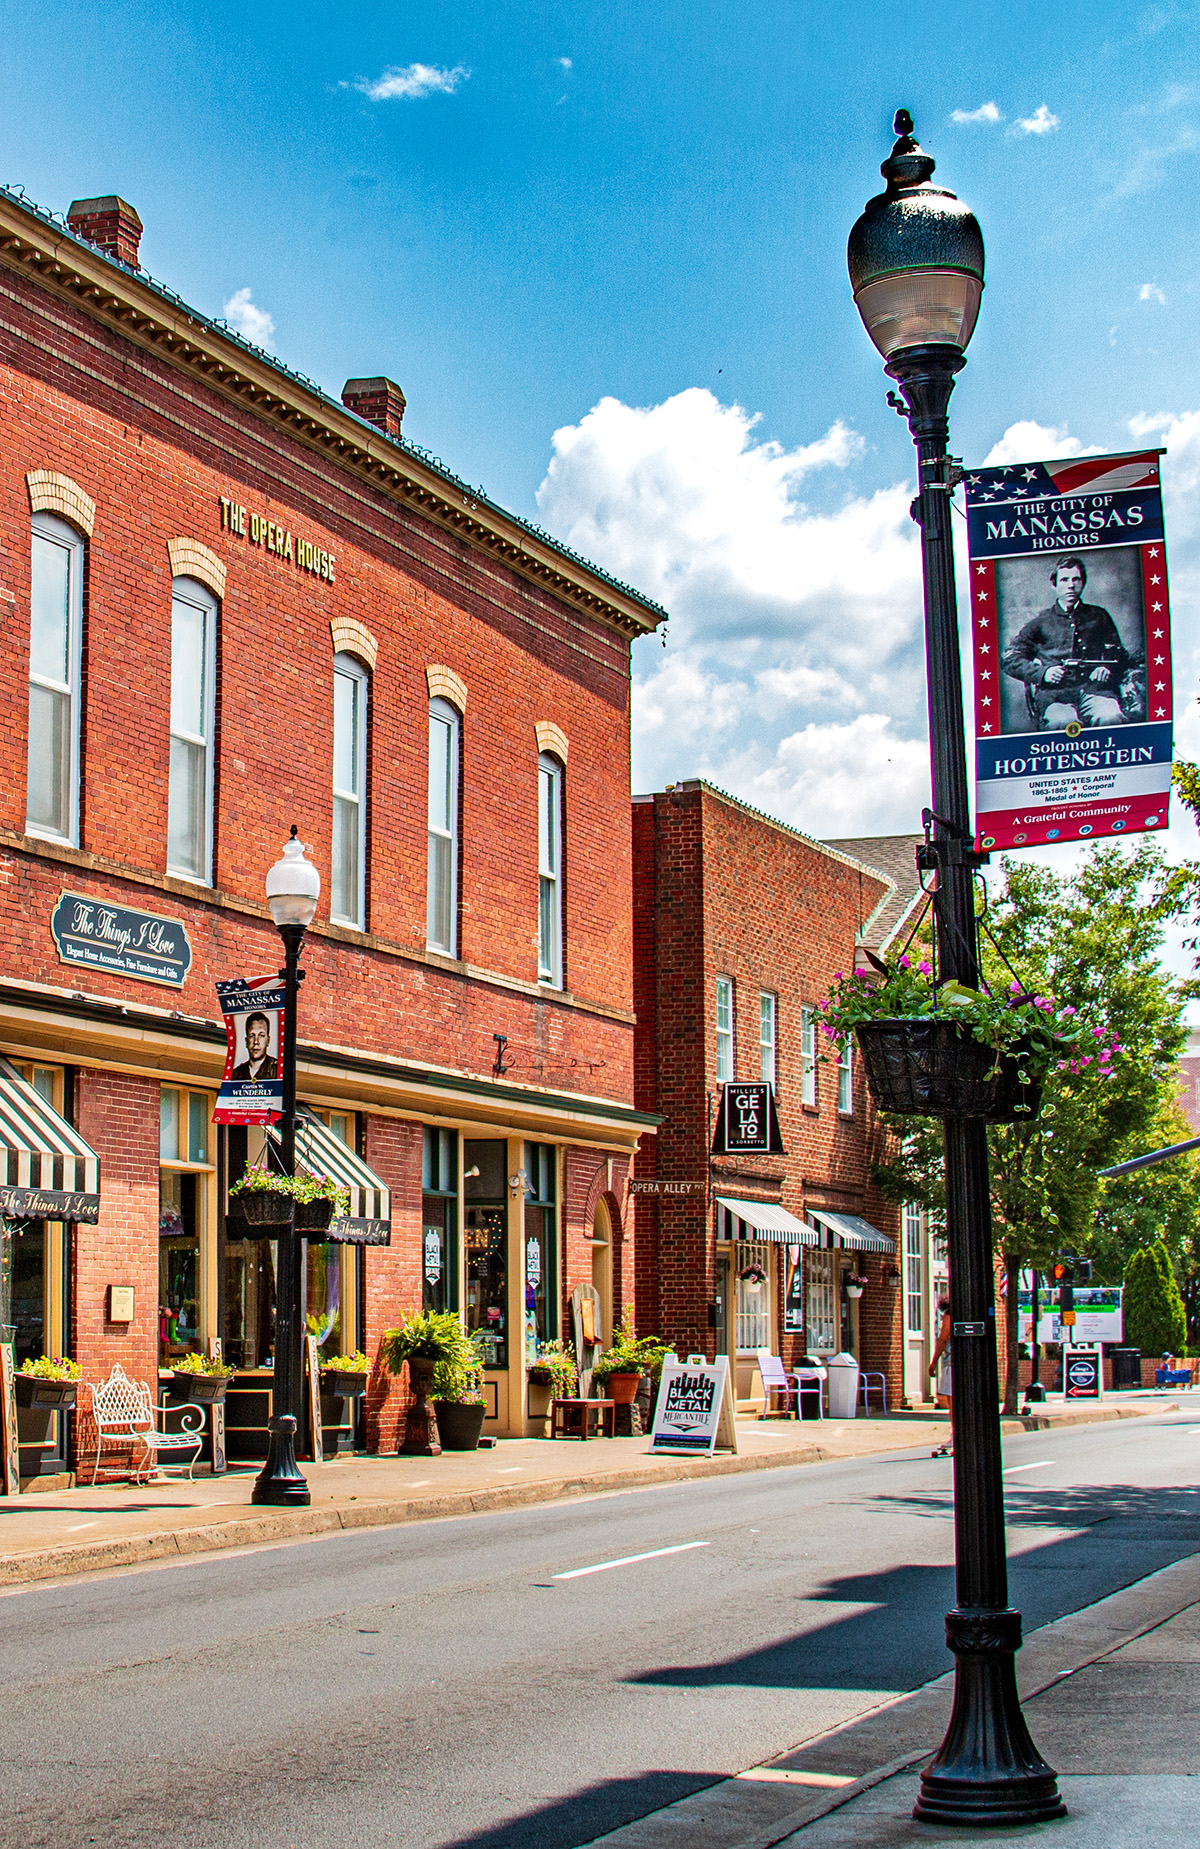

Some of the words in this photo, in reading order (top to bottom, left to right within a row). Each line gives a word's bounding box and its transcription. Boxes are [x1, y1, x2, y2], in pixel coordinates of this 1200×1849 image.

[1013, 502, 1046, 516] THE
[1050, 497, 1088, 513] CITY
[1091, 495, 1113, 508] OF
[985, 506, 1144, 540] MANASSAS
[219, 496, 247, 535] THE
[249, 512, 293, 560] OPERA
[296, 537, 336, 582] HOUSE
[1032, 532, 1100, 549] HONORS
[1030, 739, 1100, 755] Solomon
[1104, 737, 1116, 749] J.
[994, 746, 1154, 775] HOTTENSTEIN
[1029, 780, 1059, 789] UNITED
[1061, 776, 1091, 786] STATES
[1093, 774, 1117, 782] ARMY
[1032, 787, 1069, 796] 1863-1865
[1082, 782, 1115, 791] Corporal
[1045, 794, 1067, 802] Medal
[1077, 791, 1100, 799] Honor
[1012, 817, 1021, 826] A
[1023, 811, 1066, 824] Grateful
[1069, 804, 1132, 818] Community
[71, 901, 95, 935] The
[95, 907, 132, 955] Things
[146, 921, 175, 955] Love
[66, 944, 84, 958] Elegant
[84, 947, 98, 961] Home
[126, 957, 137, 970] Fine
[136, 960, 158, 974] Furniture
[157, 966, 166, 976] and
[166, 967, 178, 979] Gifts
[226, 994, 281, 1007] MANASSAS
[735, 1094, 760, 1109] GE
[740, 1109, 759, 1124] LA
[738, 1124, 758, 1139] TO
[631, 1182, 660, 1193] OPERA
[663, 1183, 692, 1194] ALLEY
[0, 1189, 21, 1209] The
[23, 1191, 58, 1213] Things
[71, 1195, 99, 1215] Love
[669, 1387, 712, 1400] BLACK
[667, 1400, 710, 1411] METAL
[663, 1412, 711, 1426] MERCANTILE
